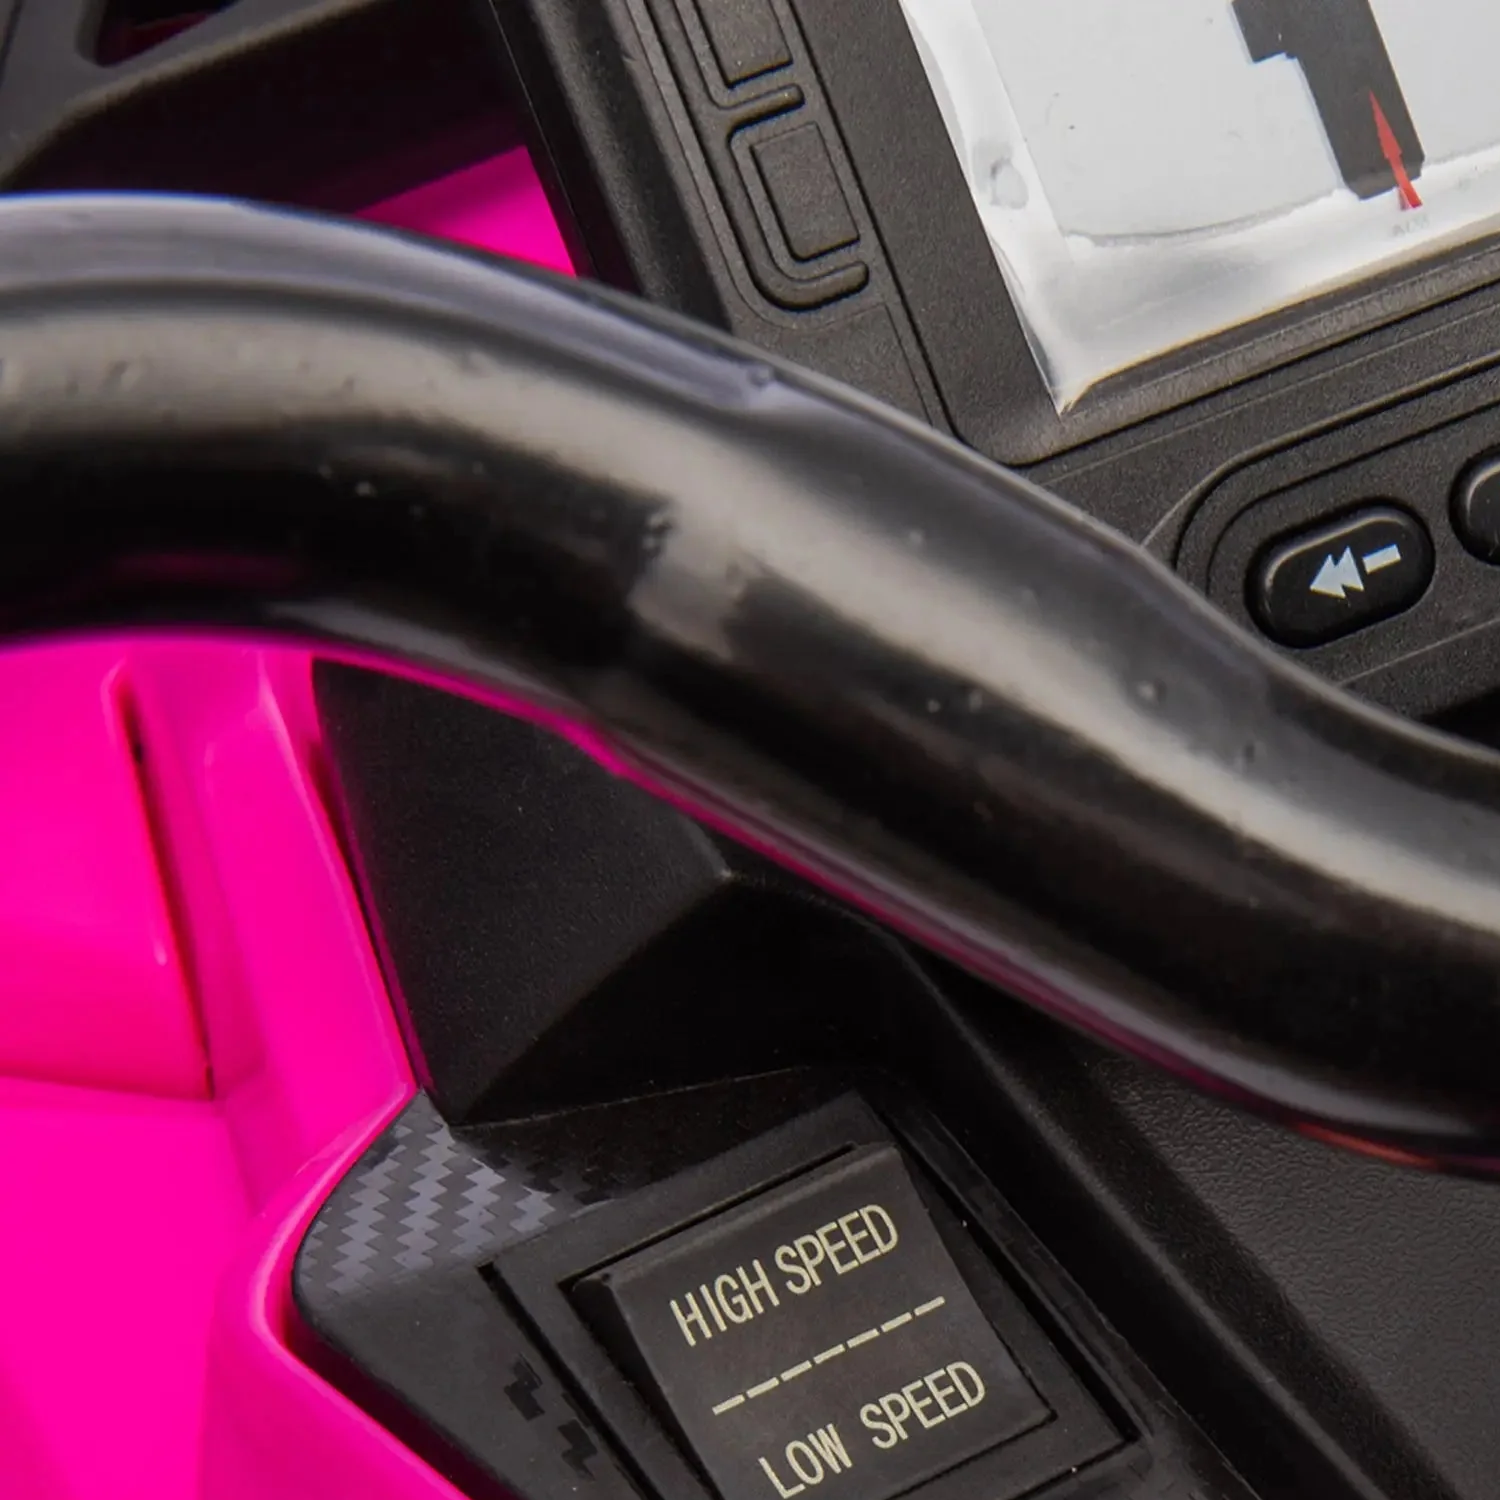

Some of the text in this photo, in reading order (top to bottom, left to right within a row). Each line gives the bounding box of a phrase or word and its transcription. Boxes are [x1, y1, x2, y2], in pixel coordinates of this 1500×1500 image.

[669, 1204, 898, 1347] HIGH SPEED
[757, 1361, 986, 1500] LOW SPEED
